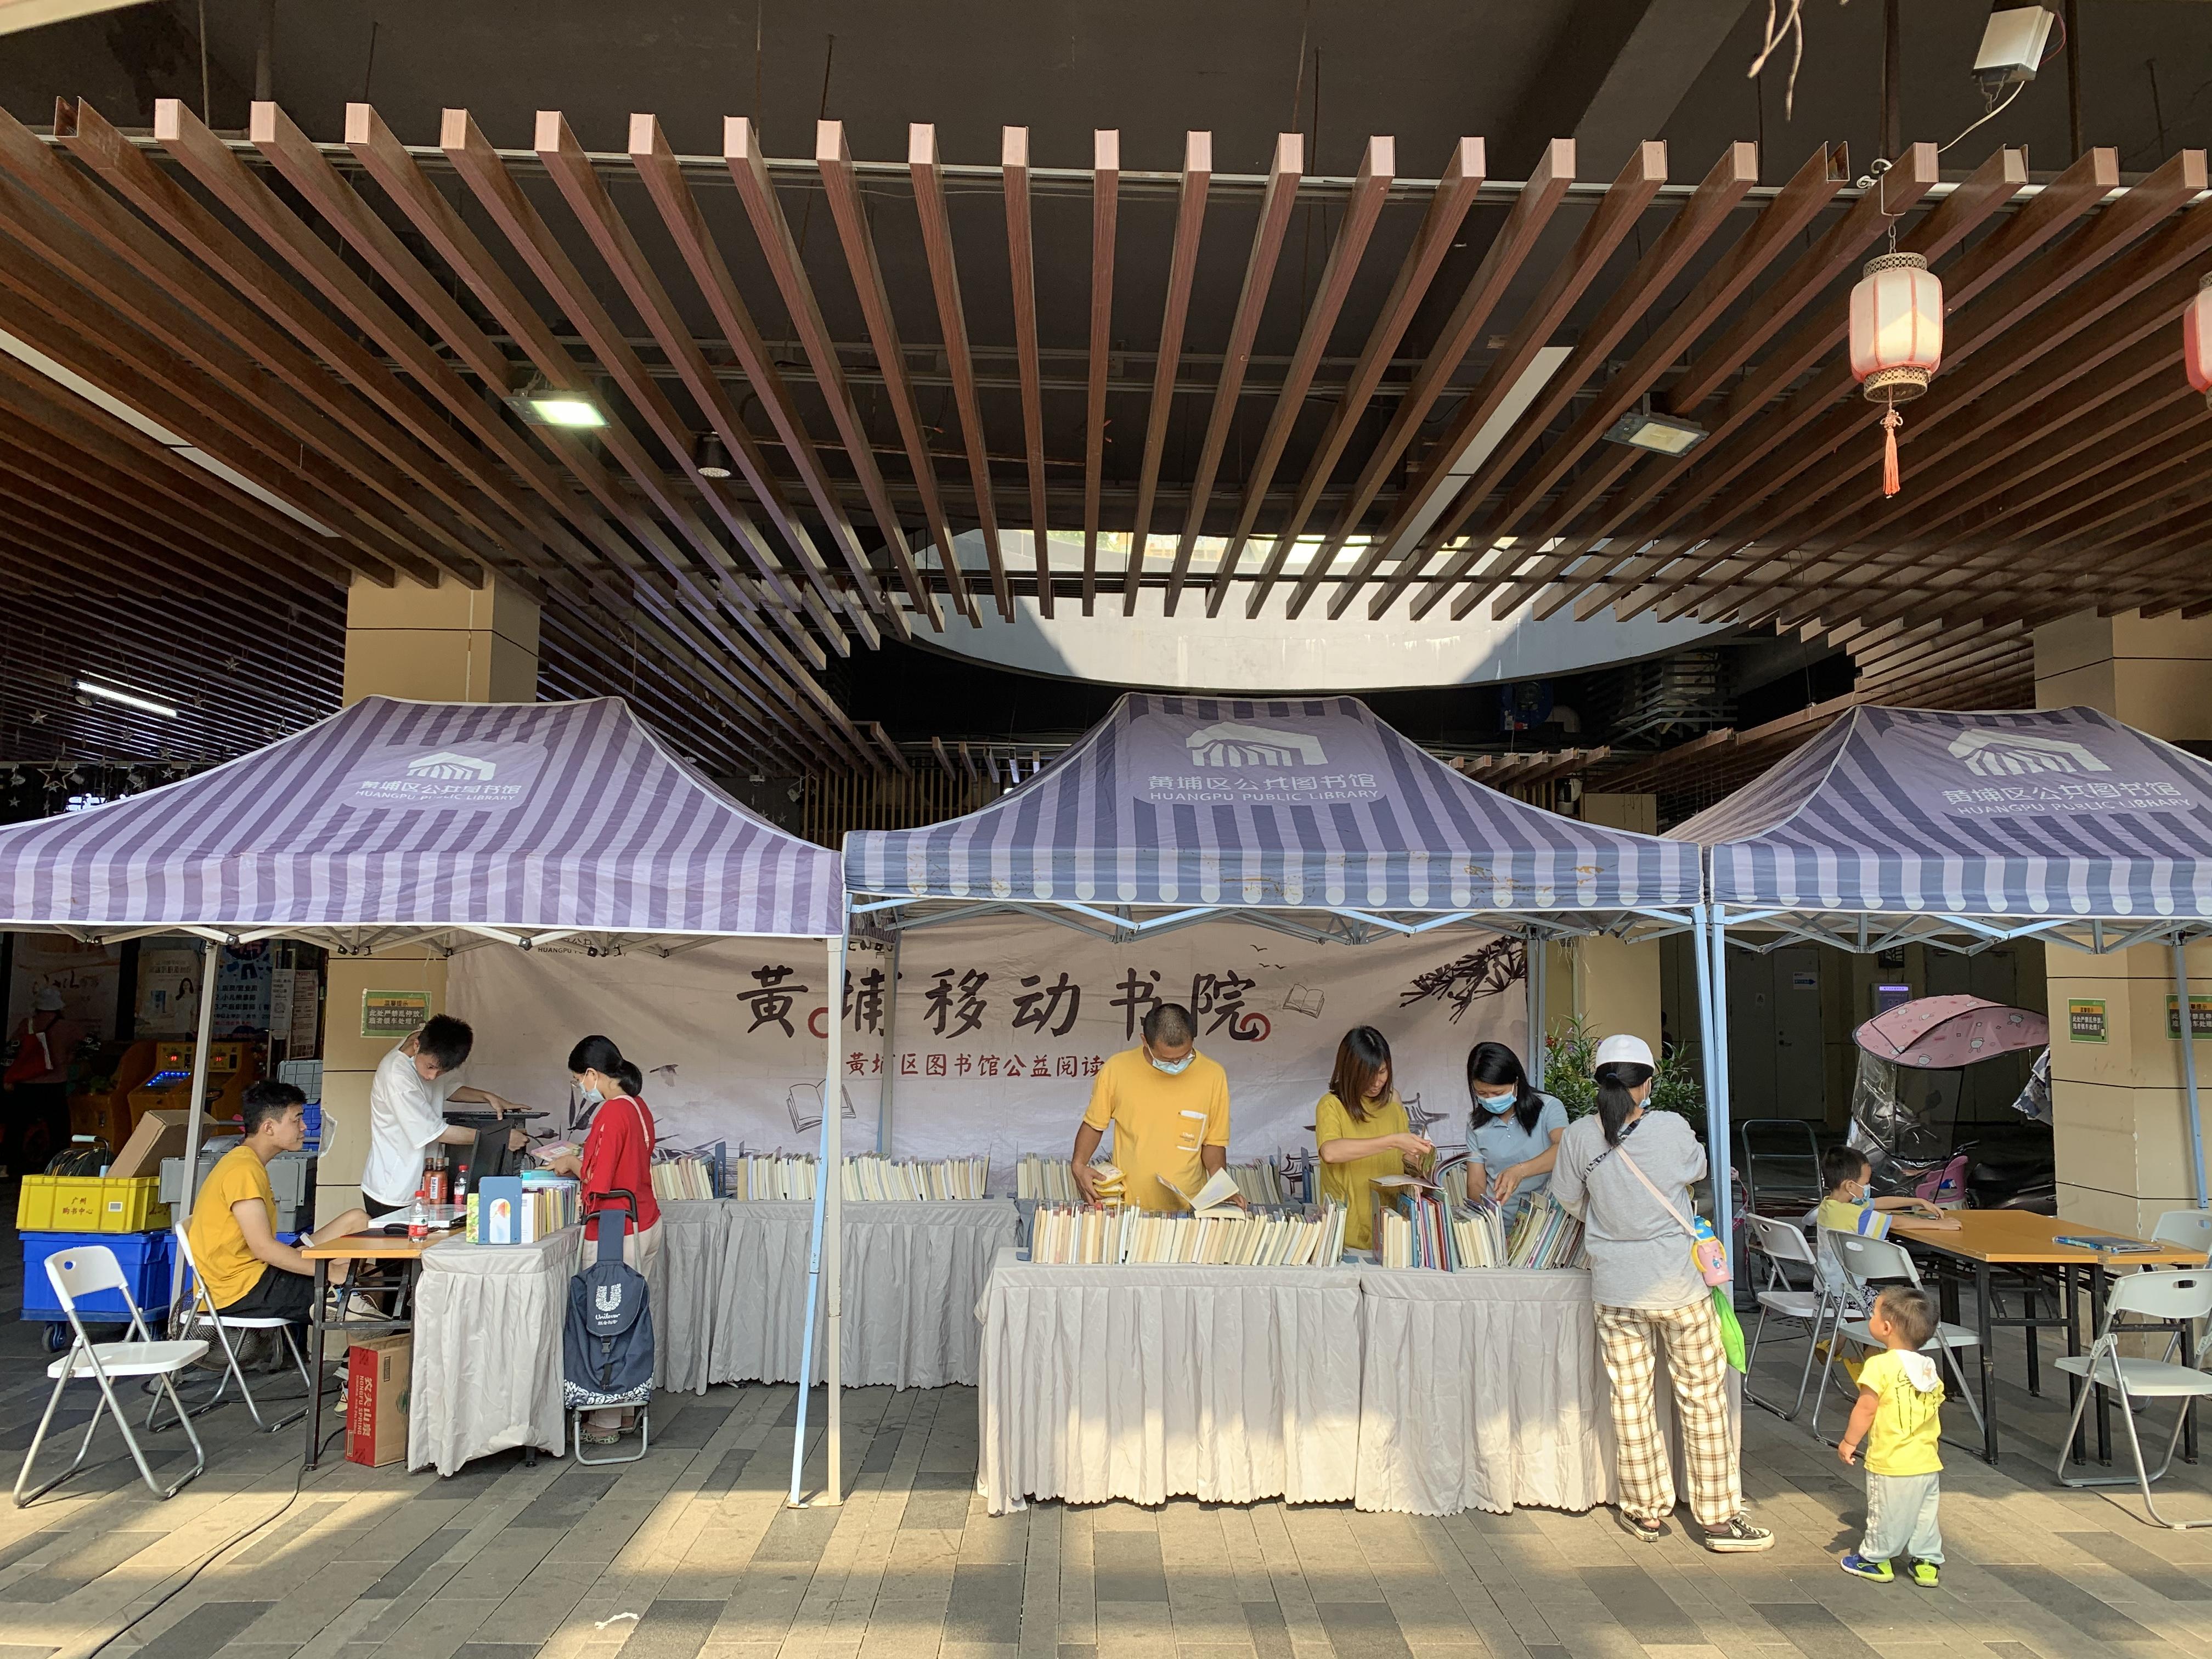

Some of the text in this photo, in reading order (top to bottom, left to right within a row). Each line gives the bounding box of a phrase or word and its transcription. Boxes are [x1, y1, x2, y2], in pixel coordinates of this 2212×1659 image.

[360, 780, 522, 795] 黄埔区公共图书馆
[1148, 773, 1377, 791] 黄埔区公共图书馆
[355, 790, 416, 800] HUANGPU
[1150, 790, 1378, 802] HUANGPU PUBLIC LIBRARY
[1942, 781, 2182, 805] 黄埔区公共图书馆
[1956, 798, 2191, 815] HUANGPU PUBLIC LIBRARY
[71, 1197, 87, 1205] 广州
[363, 1376, 373, 1436] 农夫山泉
